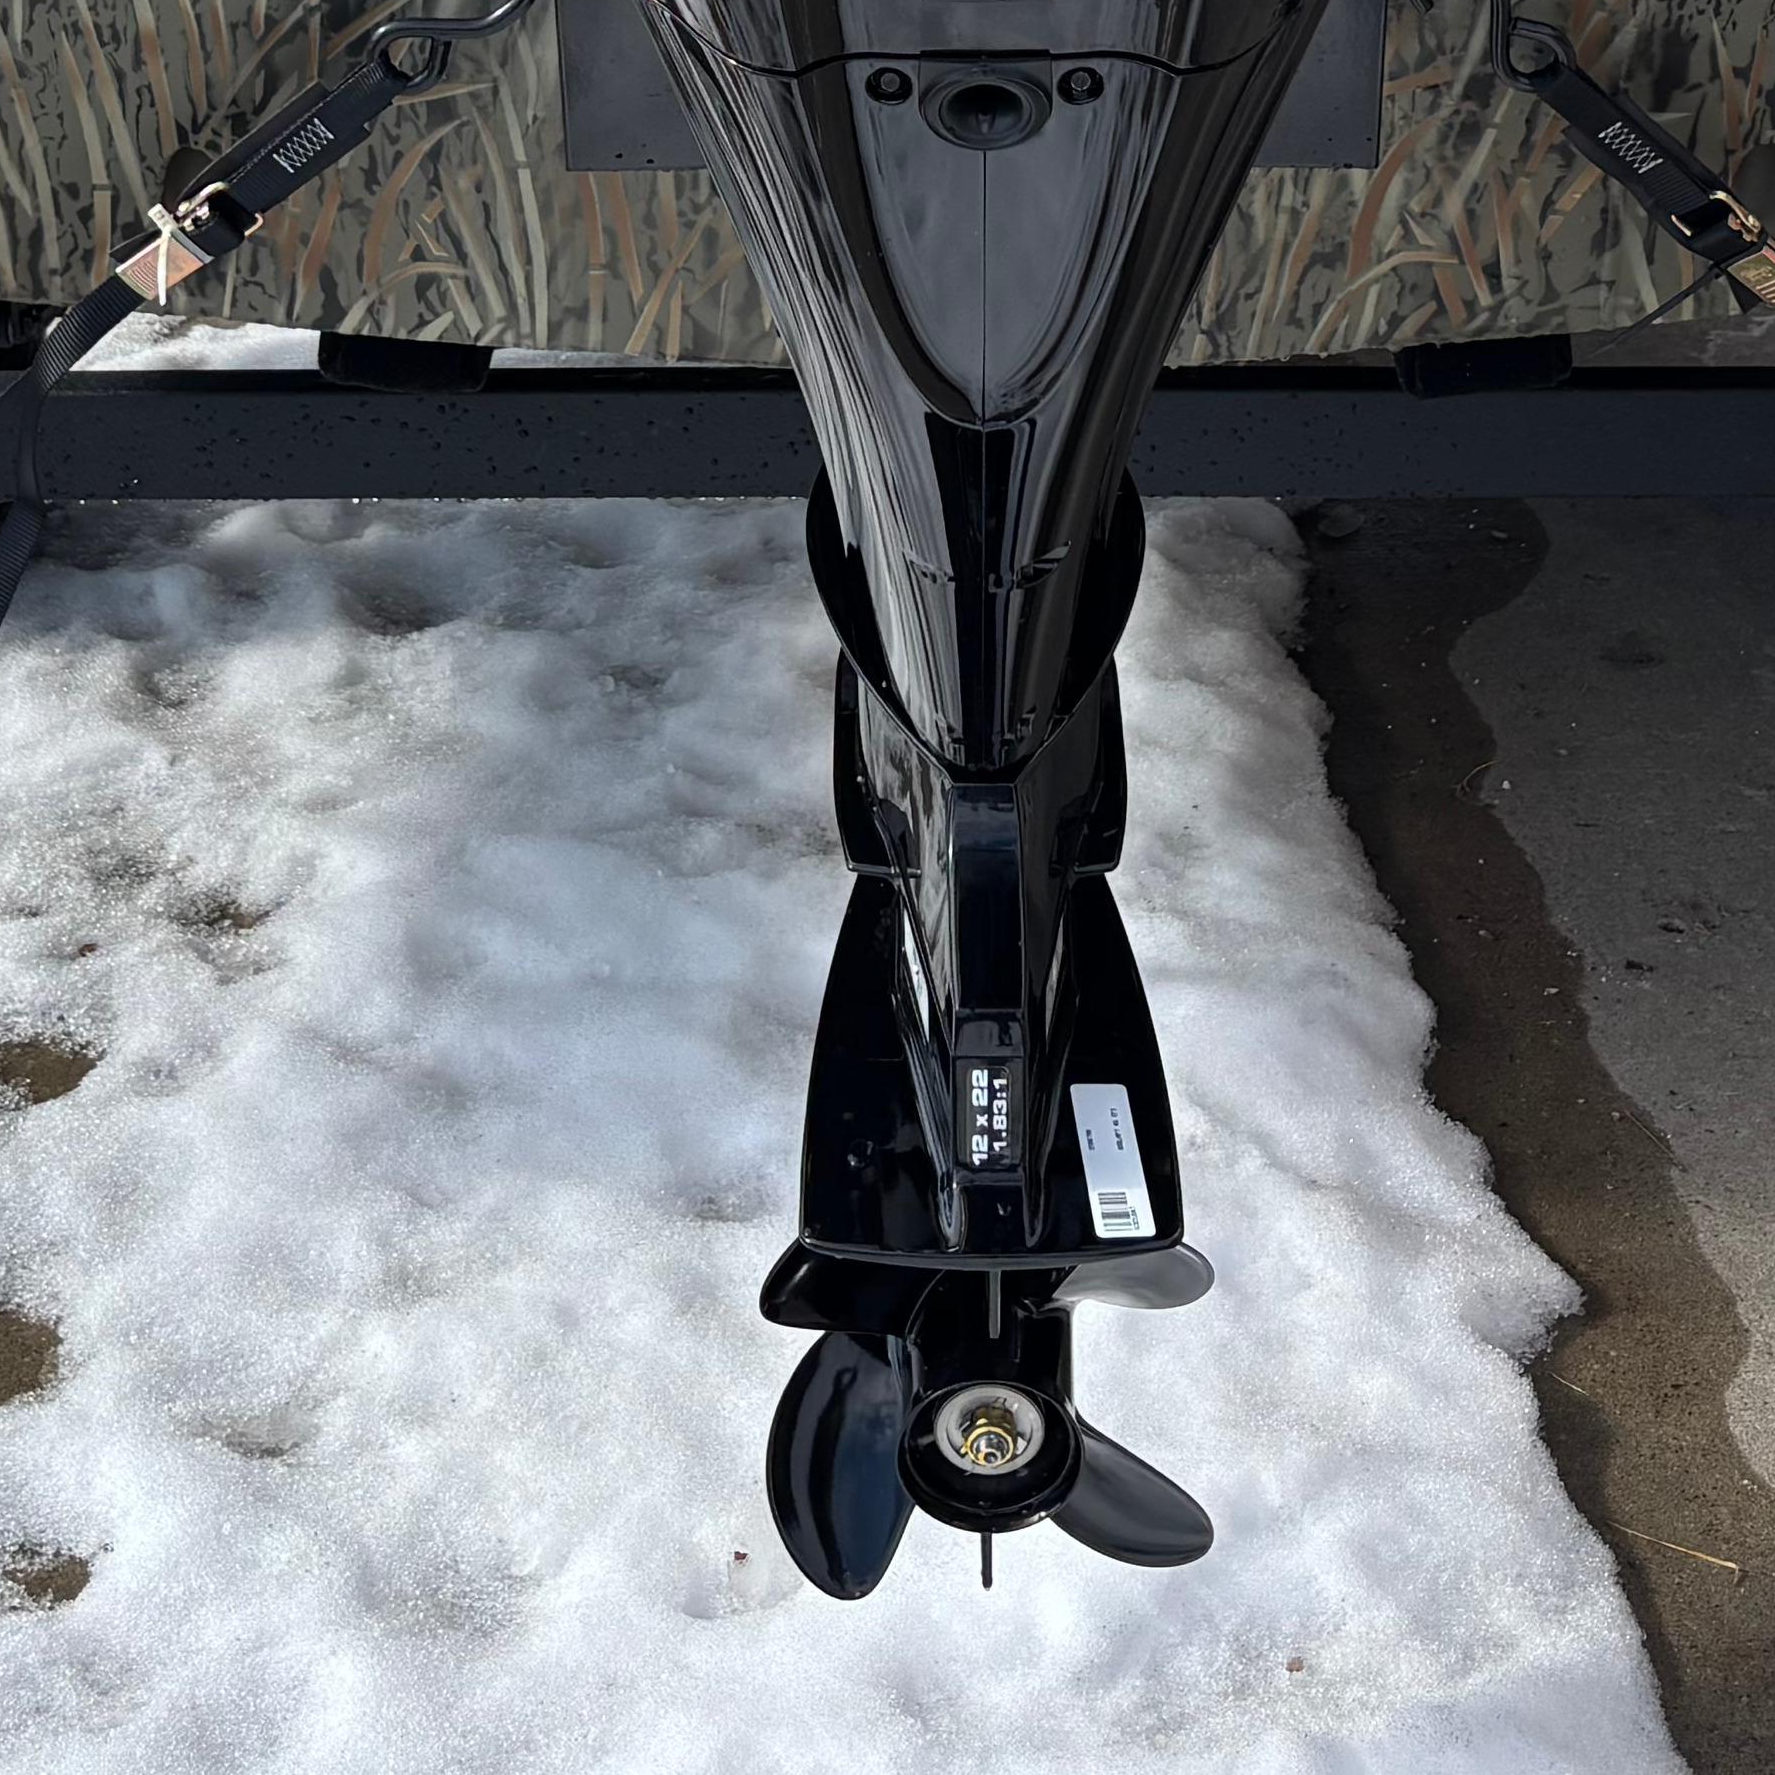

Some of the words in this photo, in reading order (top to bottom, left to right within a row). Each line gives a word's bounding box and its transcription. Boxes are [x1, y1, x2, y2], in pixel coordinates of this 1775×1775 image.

[971, 1069, 989, 1107] 22
[975, 1113, 989, 1128] x
[993, 1078, 1008, 1152] 1.83:1
[971, 1134, 989, 1166] 12
